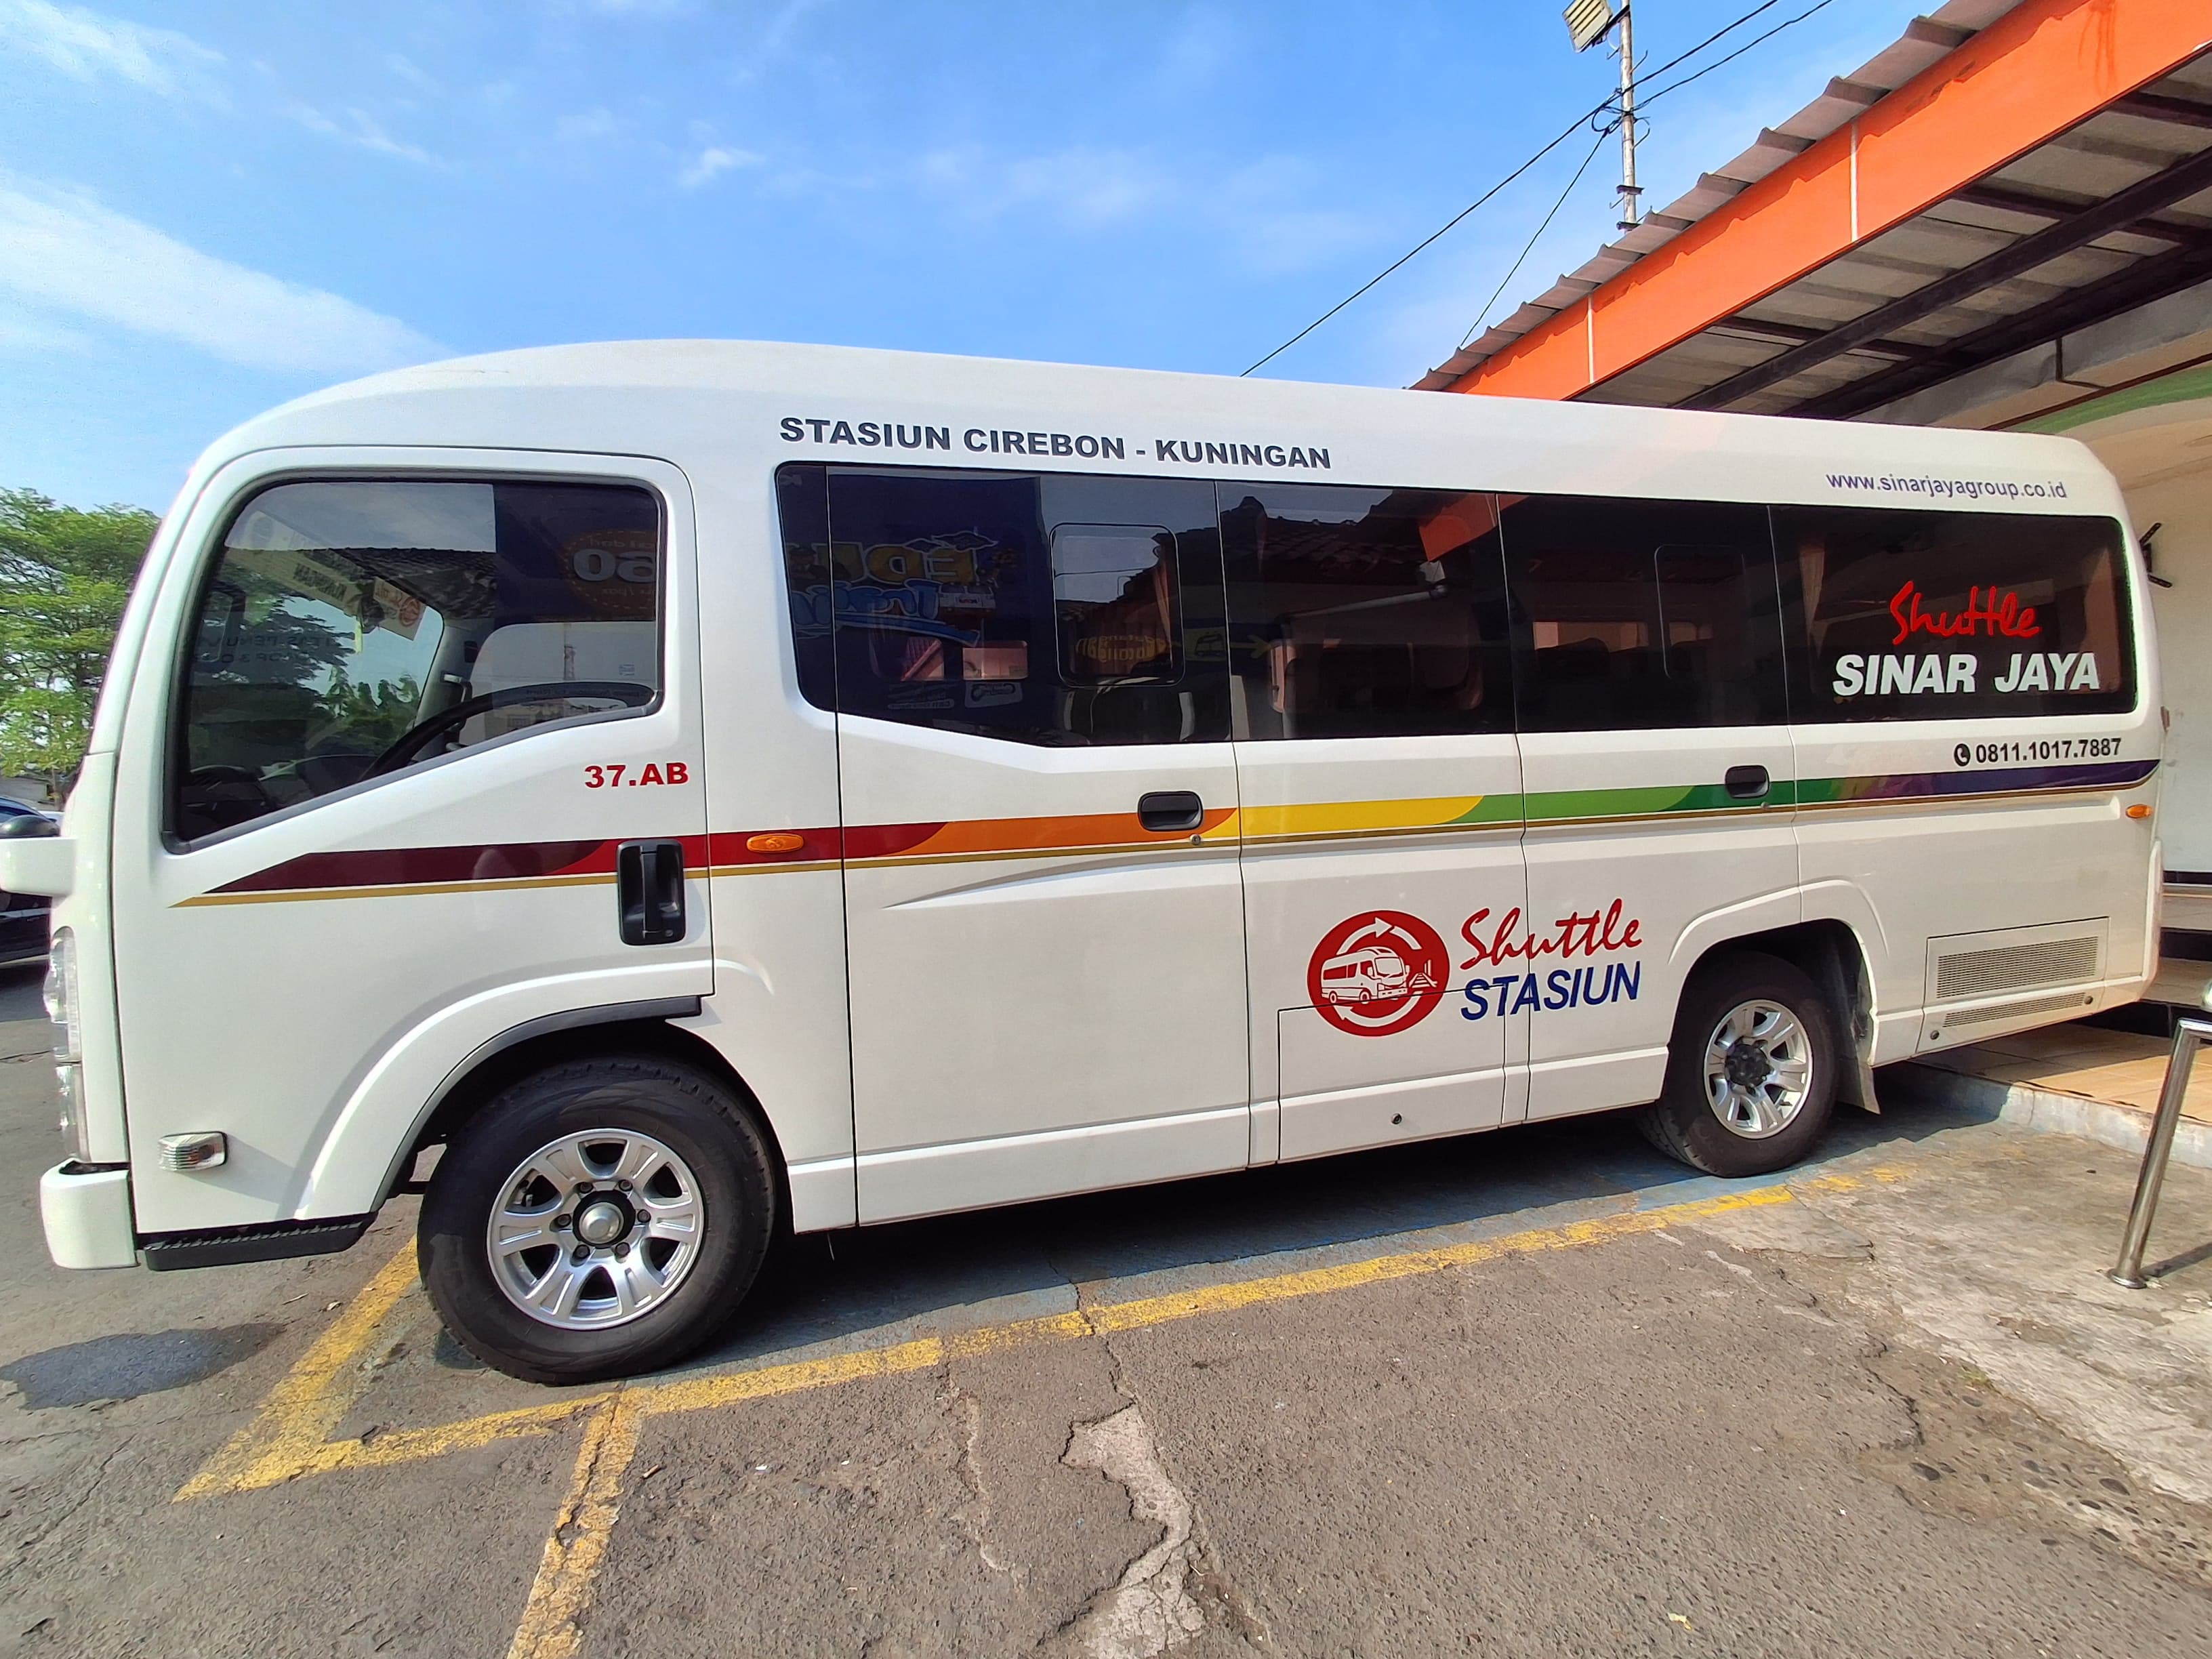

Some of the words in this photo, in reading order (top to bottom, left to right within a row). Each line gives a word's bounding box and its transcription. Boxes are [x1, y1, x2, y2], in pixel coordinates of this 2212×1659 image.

[779, 416, 951, 451] STASIUN
[963, 428, 1126, 460] CIREBON
[1154, 438, 1332, 470] KUNINGAN
[1825, 473, 2068, 501] www.sinarjayagroup.co.id
[1889, 579, 2043, 647] Shuttle
[1832, 653, 1978, 696] SINAR
[1994, 652, 2100, 693] JAYA
[1975, 737, 2123, 764] 0811.1017.7887
[585, 762, 690, 789] 37.AB
[1460, 898, 1643, 971] Shuttle
[1460, 961, 1641, 1021] STASIUN
